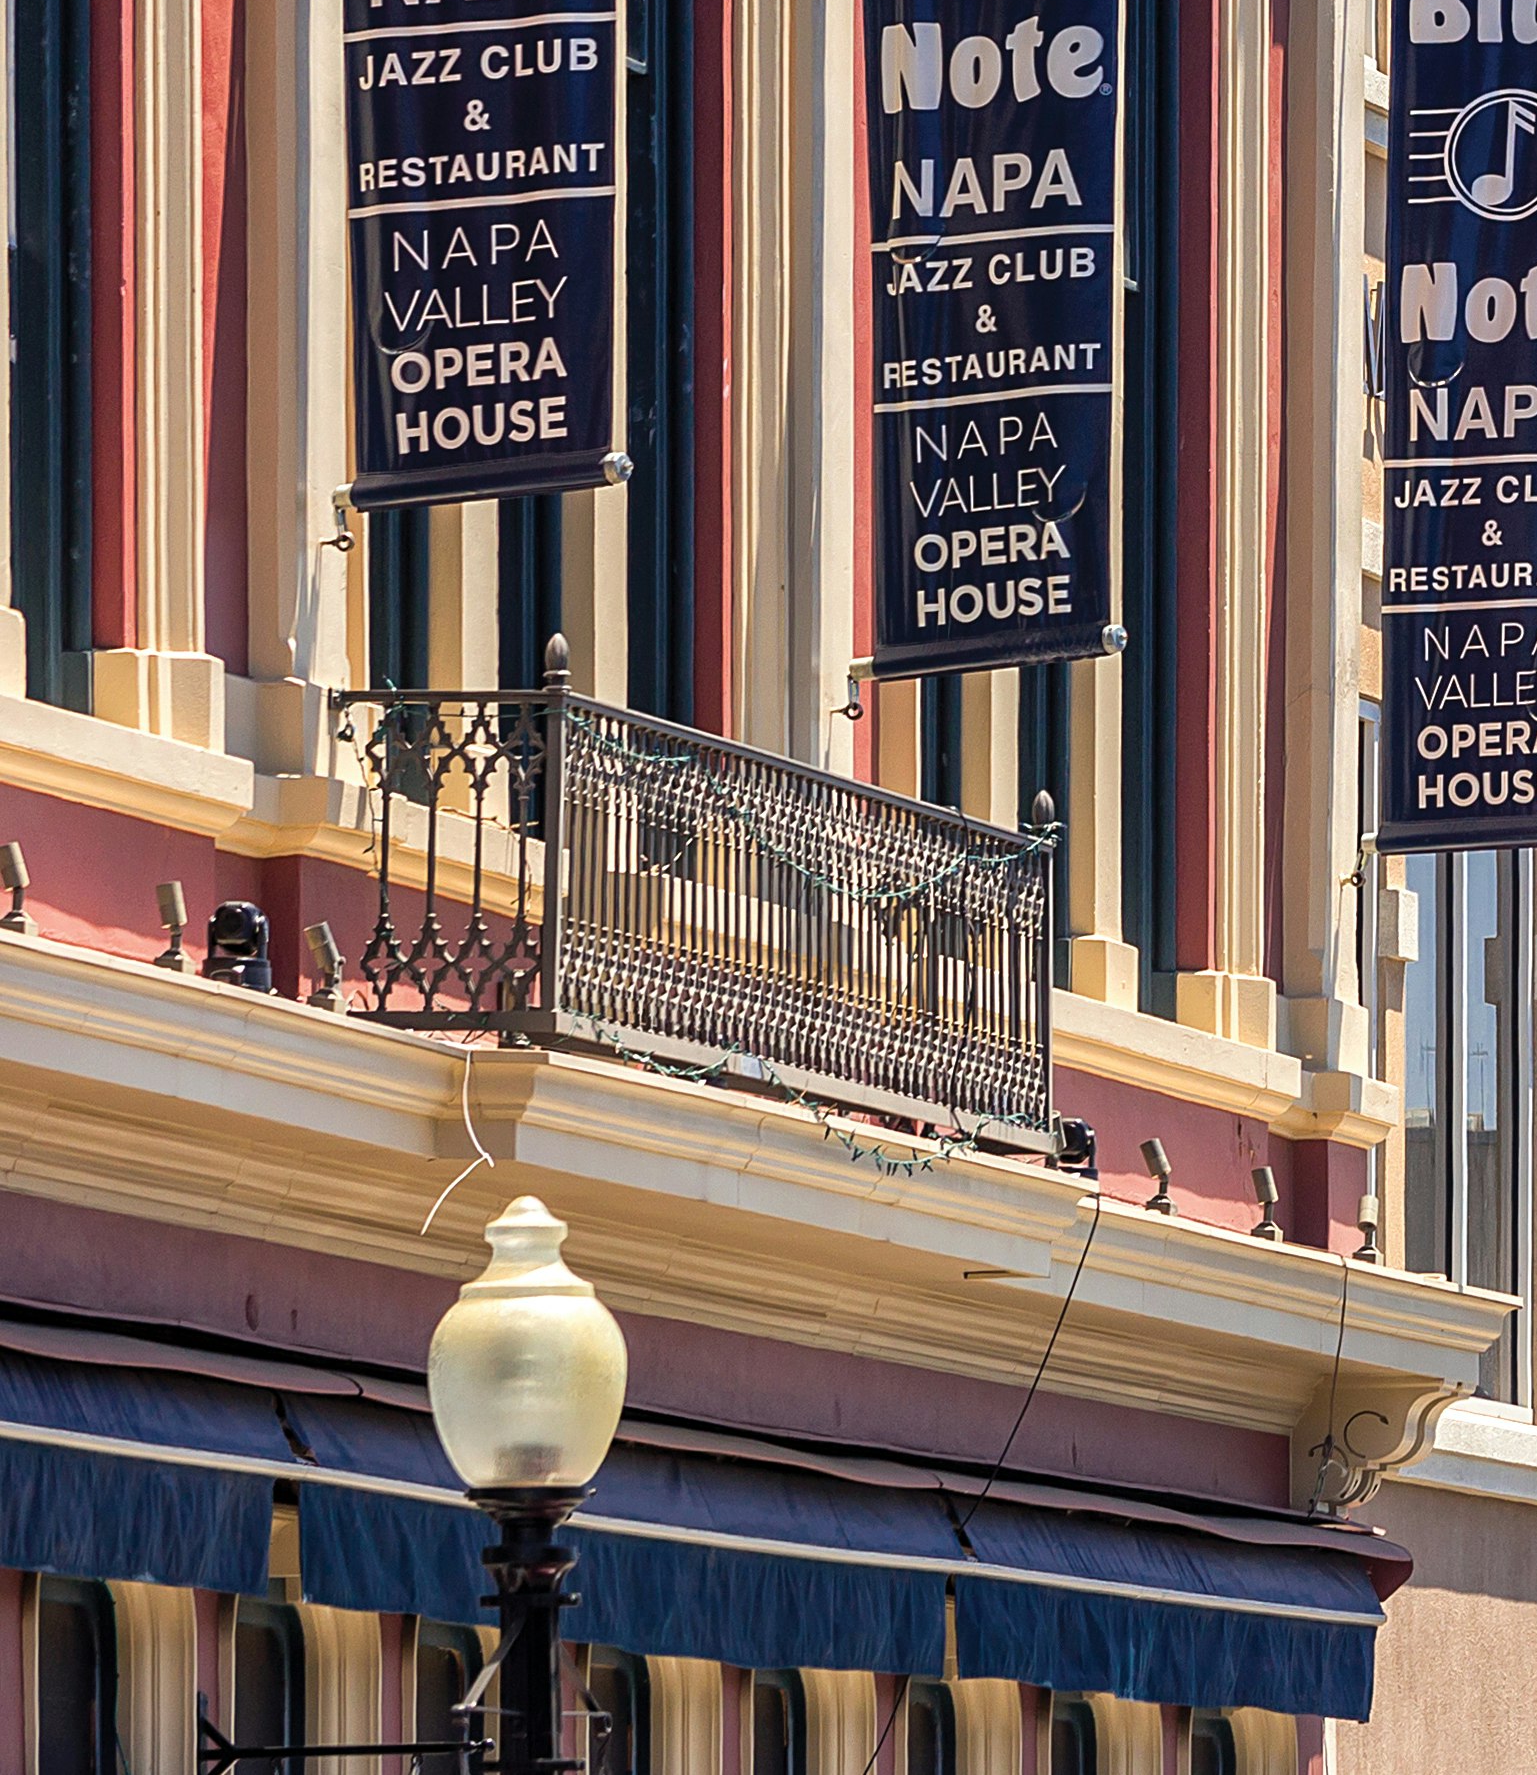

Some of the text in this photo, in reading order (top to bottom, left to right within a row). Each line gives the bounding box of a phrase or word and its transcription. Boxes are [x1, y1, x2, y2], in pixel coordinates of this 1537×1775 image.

[359, 38, 597, 90] JAZZ CLUB
[464, 100, 490, 131] &
[360, 143, 605, 192] RESTAURANT
[892, 149, 1082, 220] NAPA
[394, 219, 558, 271] NAPA
[886, 248, 1095, 296] JAZZ CLUB
[385, 276, 567, 331] VALLEY
[976, 305, 997, 333] &
[390, 338, 567, 393] OPERA
[884, 343, 1100, 388] RESTAURANT
[396, 396, 567, 454] HOUSE
[916, 412, 1057, 463] NAPA
[910, 465, 1065, 517] VALLEY
[1394, 477, 1481, 508] JAZZ
[914, 521, 1070, 572] OPERA
[1482, 520, 1502, 546] &
[917, 575, 1071, 627] HOUSE
